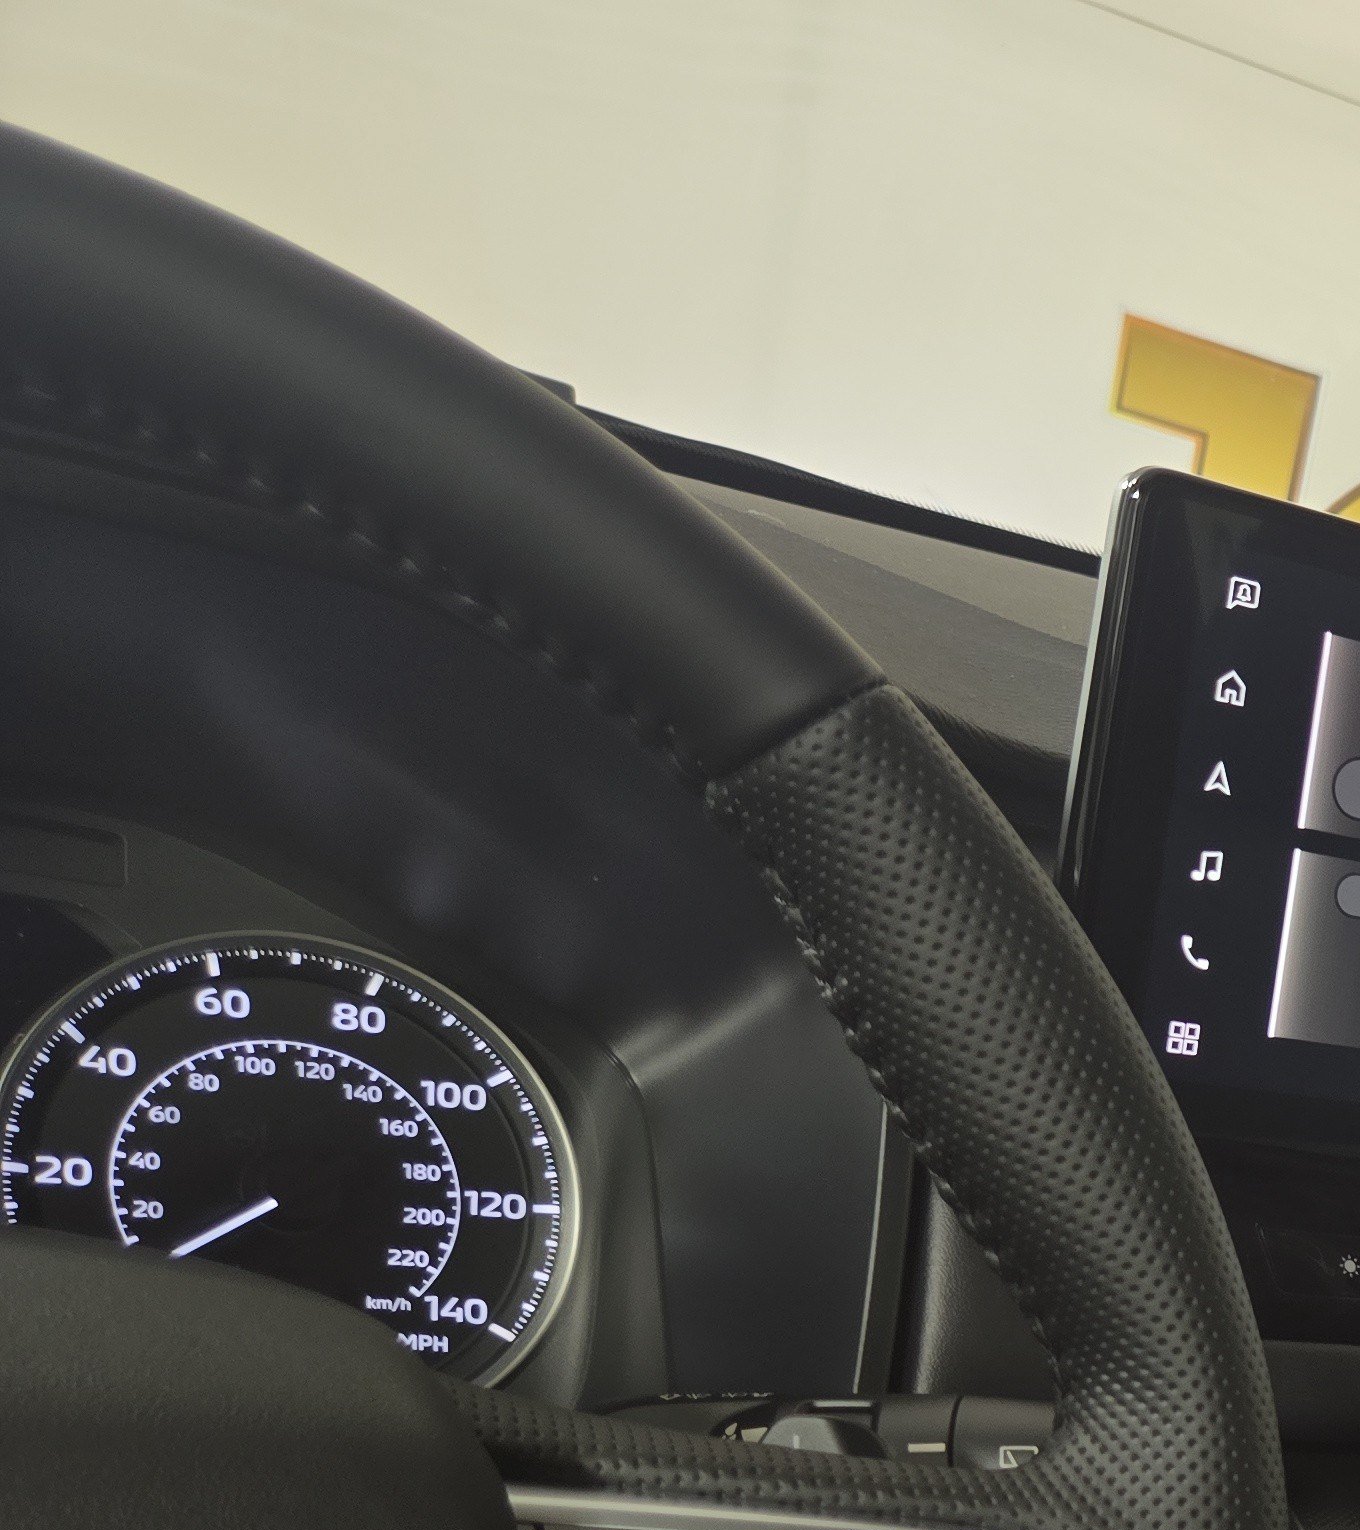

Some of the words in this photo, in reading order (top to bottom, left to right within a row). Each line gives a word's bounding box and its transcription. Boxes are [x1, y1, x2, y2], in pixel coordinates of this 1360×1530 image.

[195, 988, 252, 1020] 60
[331, 1002, 386, 1035] 80
[77, 1045, 137, 1078] 40
[234, 1056, 276, 1078] 100
[295, 1060, 335, 1081] 120
[188, 1072, 220, 1093] 80
[342, 1083, 383, 1104] 140
[420, 1079, 487, 1112] 100
[148, 1105, 181, 1125] 60
[380, 1118, 418, 1138] 160
[34, 1155, 92, 1187] 20
[128, 1151, 161, 1171] 40
[402, 1163, 442, 1182] 180
[132, 1200, 164, 1219] 20
[463, 1190, 527, 1219] 120
[402, 1207, 446, 1226] 200
[387, 1250, 430, 1268] 220
[365, 1295, 411, 1313] km/h
[424, 1295, 488, 1324] 140
[397, 1333, 449, 1354] MPH
